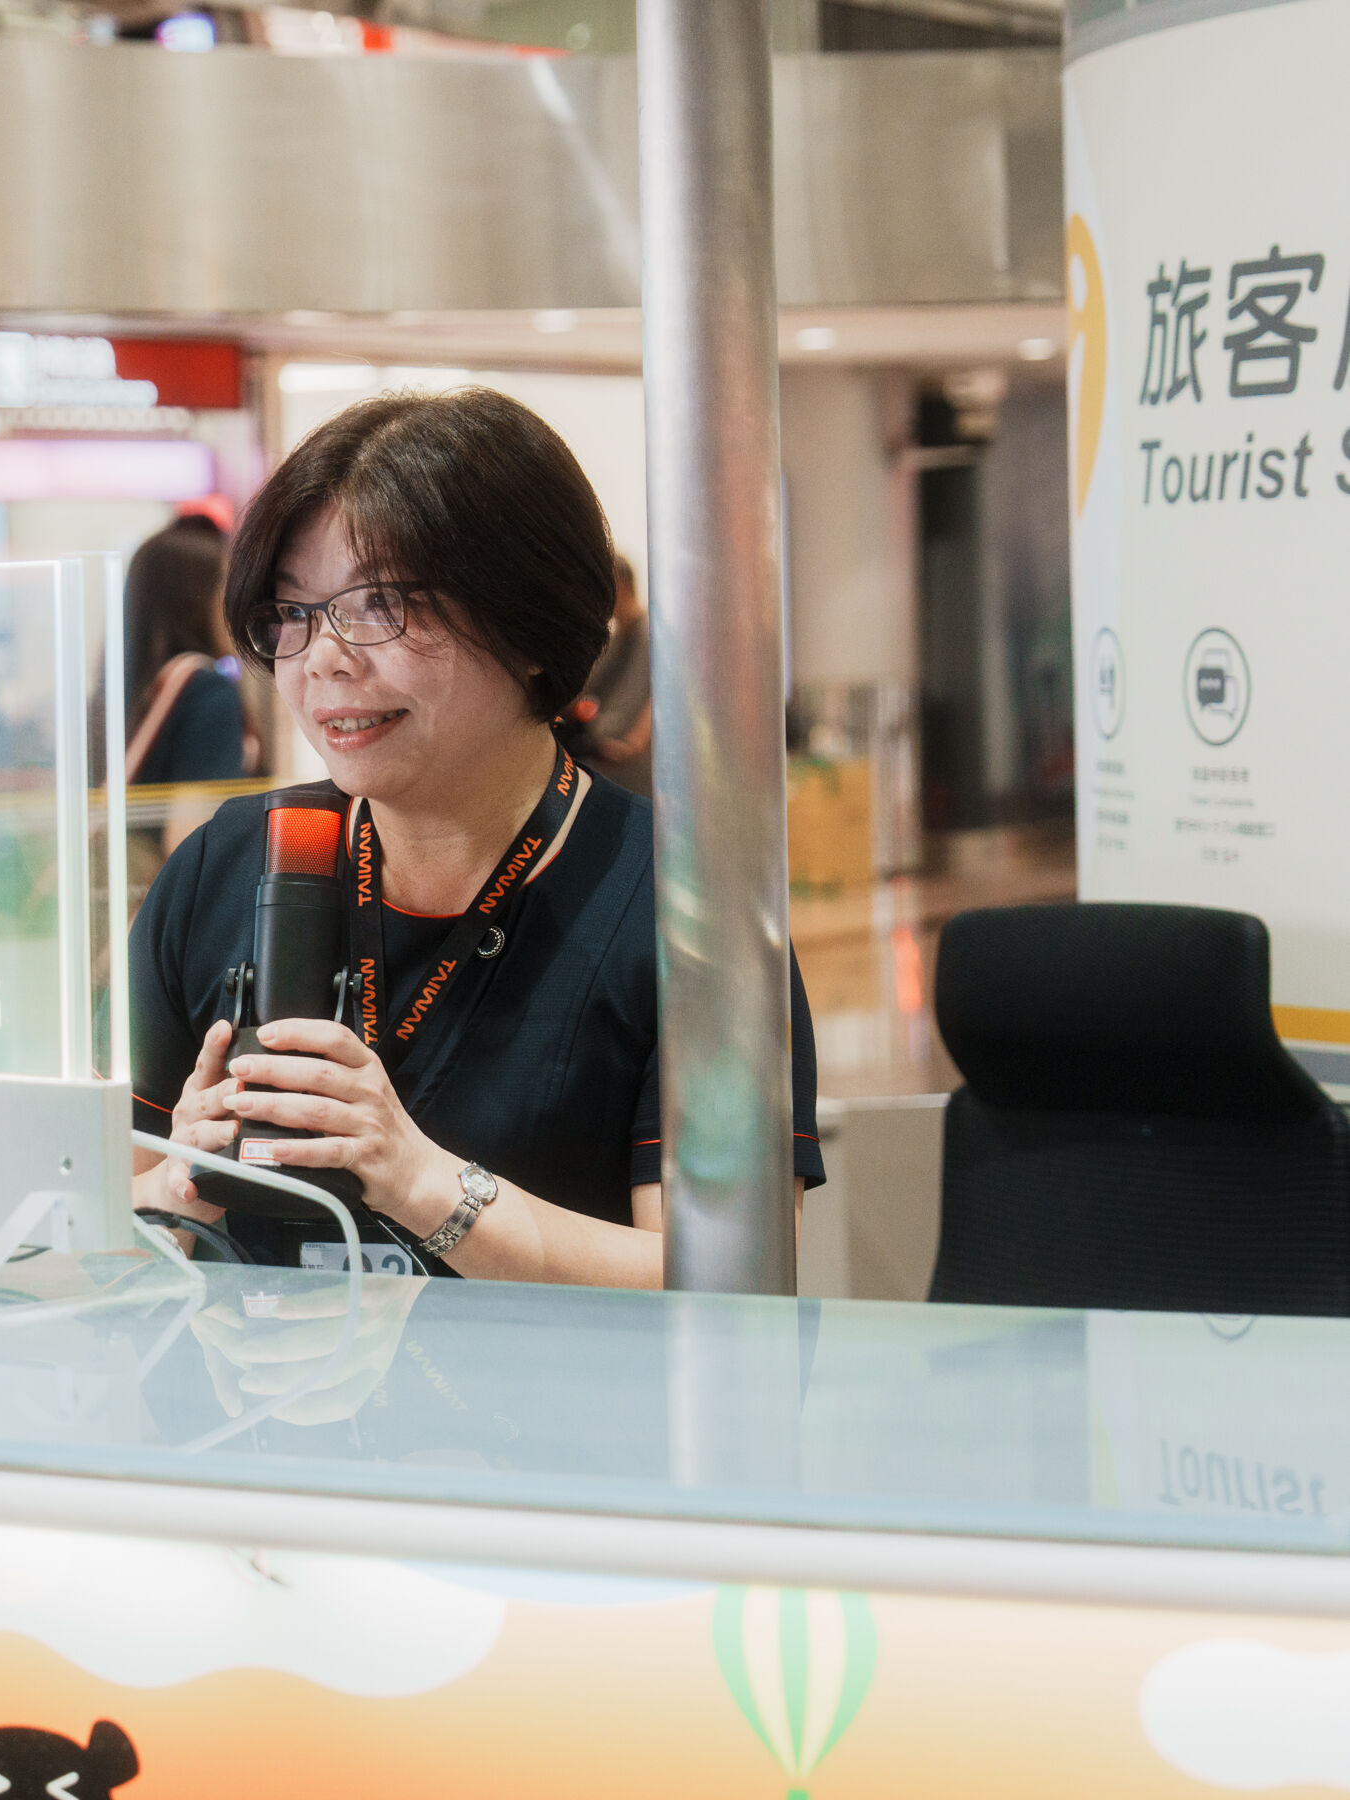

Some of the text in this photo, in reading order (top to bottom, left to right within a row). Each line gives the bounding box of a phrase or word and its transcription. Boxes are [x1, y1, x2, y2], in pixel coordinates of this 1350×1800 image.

[1140, 244, 1350, 405] 旅客
[1140, 432, 1313, 504] Tourist
[357, 822, 372, 906] TAIWAN
[479, 836, 542, 914] TAIWAN
[360, 958, 379, 1045] TAIWAN
[395, 958, 457, 1040] TAIWAN
